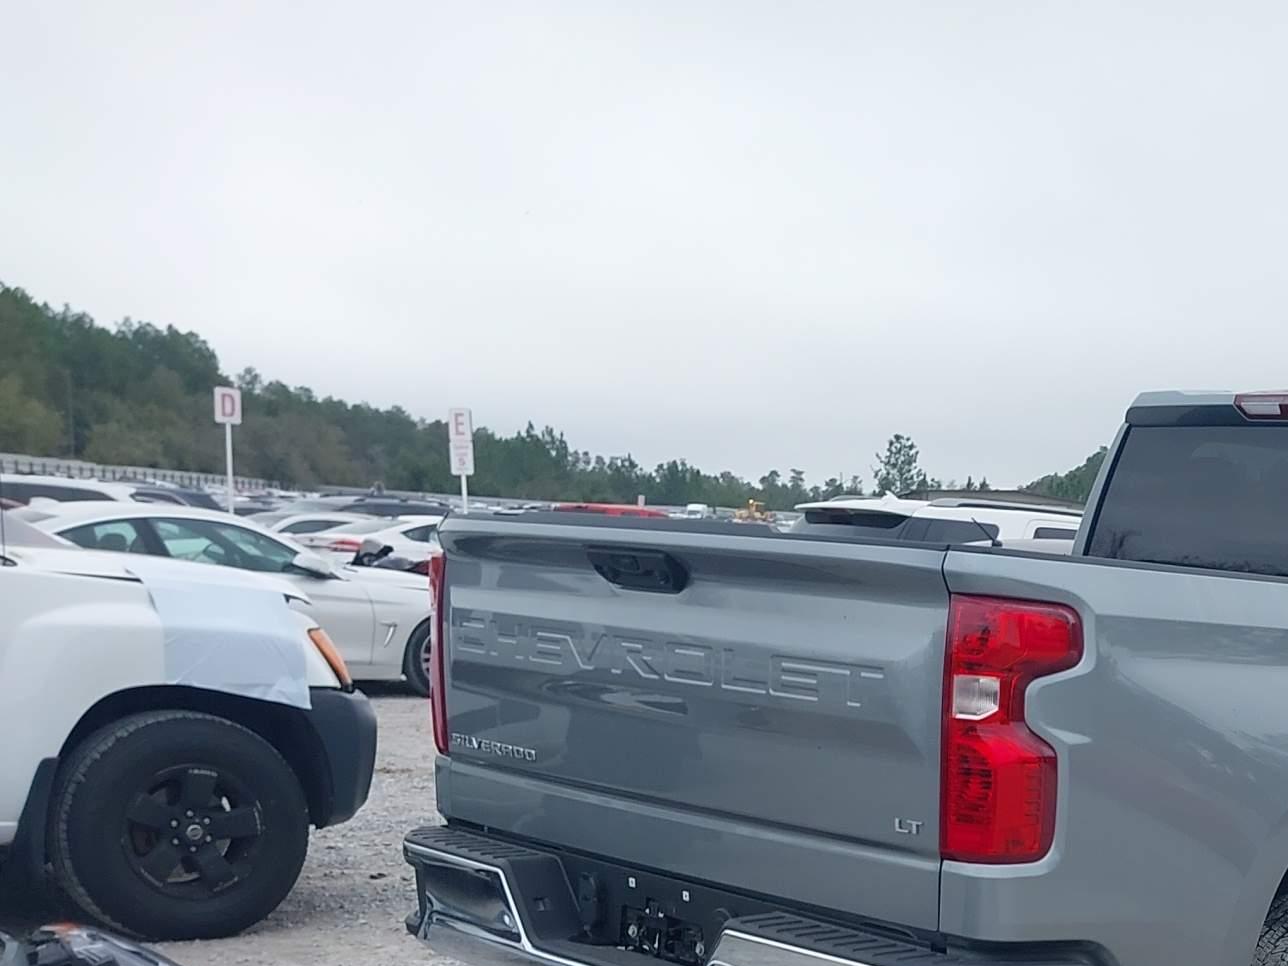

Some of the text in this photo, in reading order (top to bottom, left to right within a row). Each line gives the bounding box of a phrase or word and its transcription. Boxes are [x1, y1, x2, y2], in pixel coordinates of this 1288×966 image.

[221, 393, 235, 417] D
[454, 412, 465, 436] E
[456, 616, 885, 707] CHEVROLET
[451, 732, 537, 761] SILVERADO
[895, 817, 923, 835] LT
